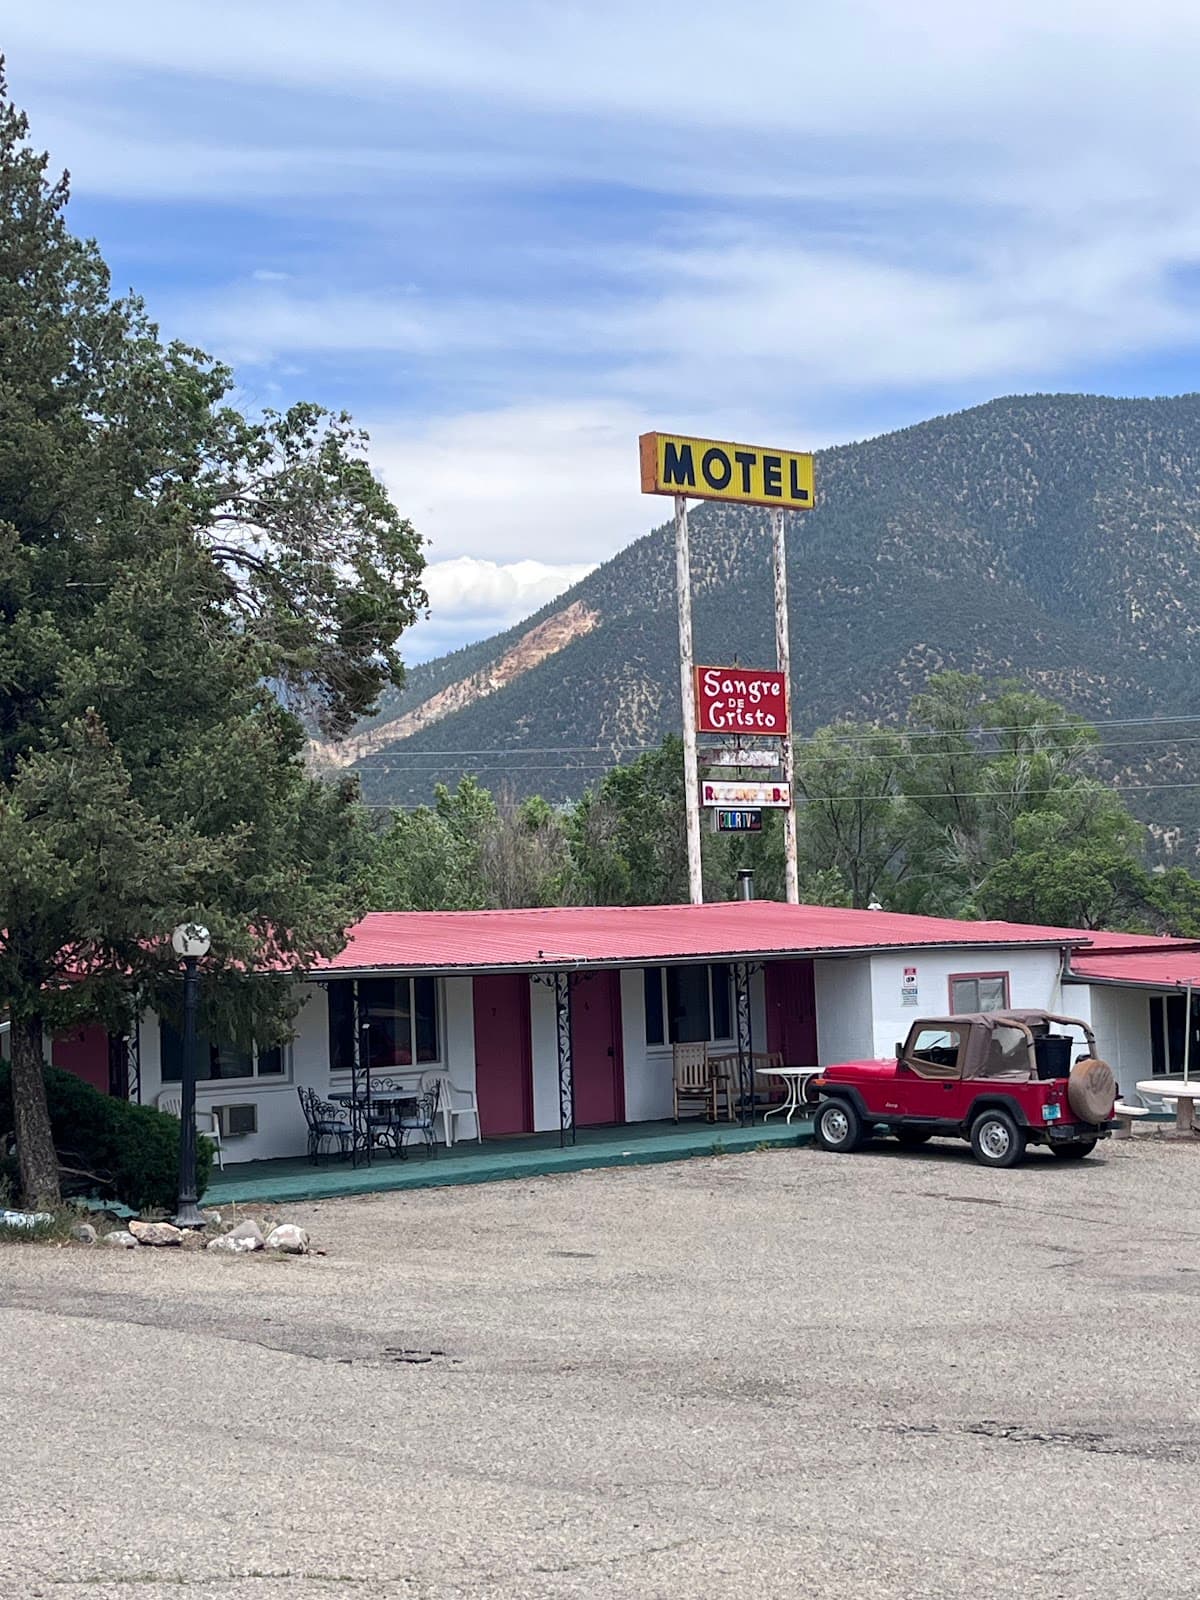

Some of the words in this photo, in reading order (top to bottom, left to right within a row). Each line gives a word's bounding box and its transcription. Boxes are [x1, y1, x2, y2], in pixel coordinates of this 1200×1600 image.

[663, 442, 808, 500] MOTEL
[704, 670, 780, 703] Sangre
[709, 700, 776, 728] Cristo
[728, 698, 744, 708] DE
